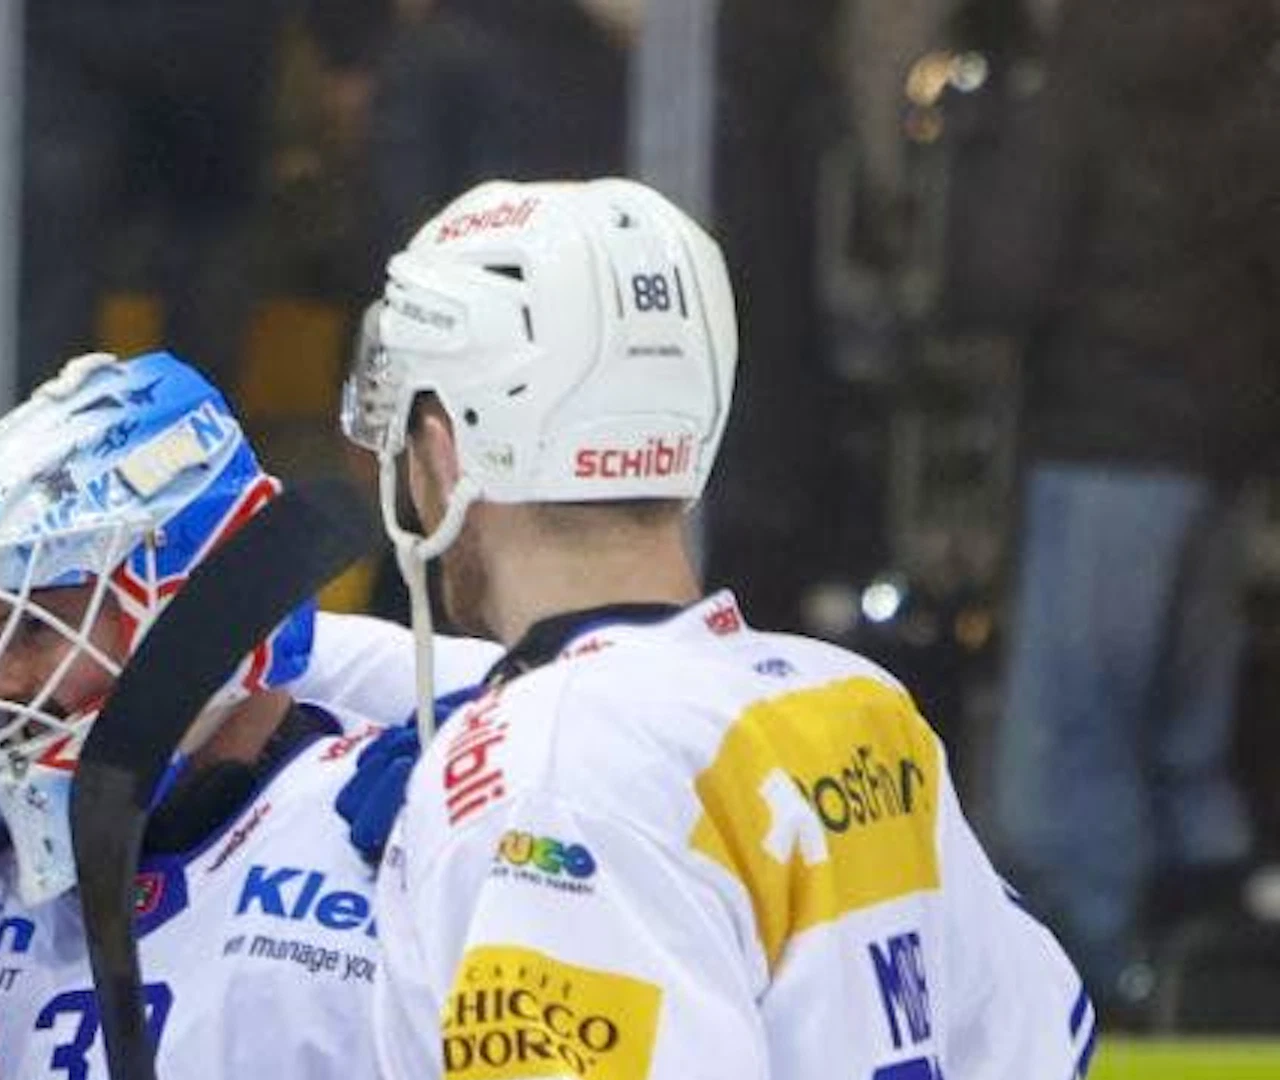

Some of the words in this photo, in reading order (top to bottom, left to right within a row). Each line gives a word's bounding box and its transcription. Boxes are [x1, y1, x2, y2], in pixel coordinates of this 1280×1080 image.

[631, 274, 671, 312] 88
[235, 864, 378, 940] Kle
[443, 988, 619, 1053] HICCO
